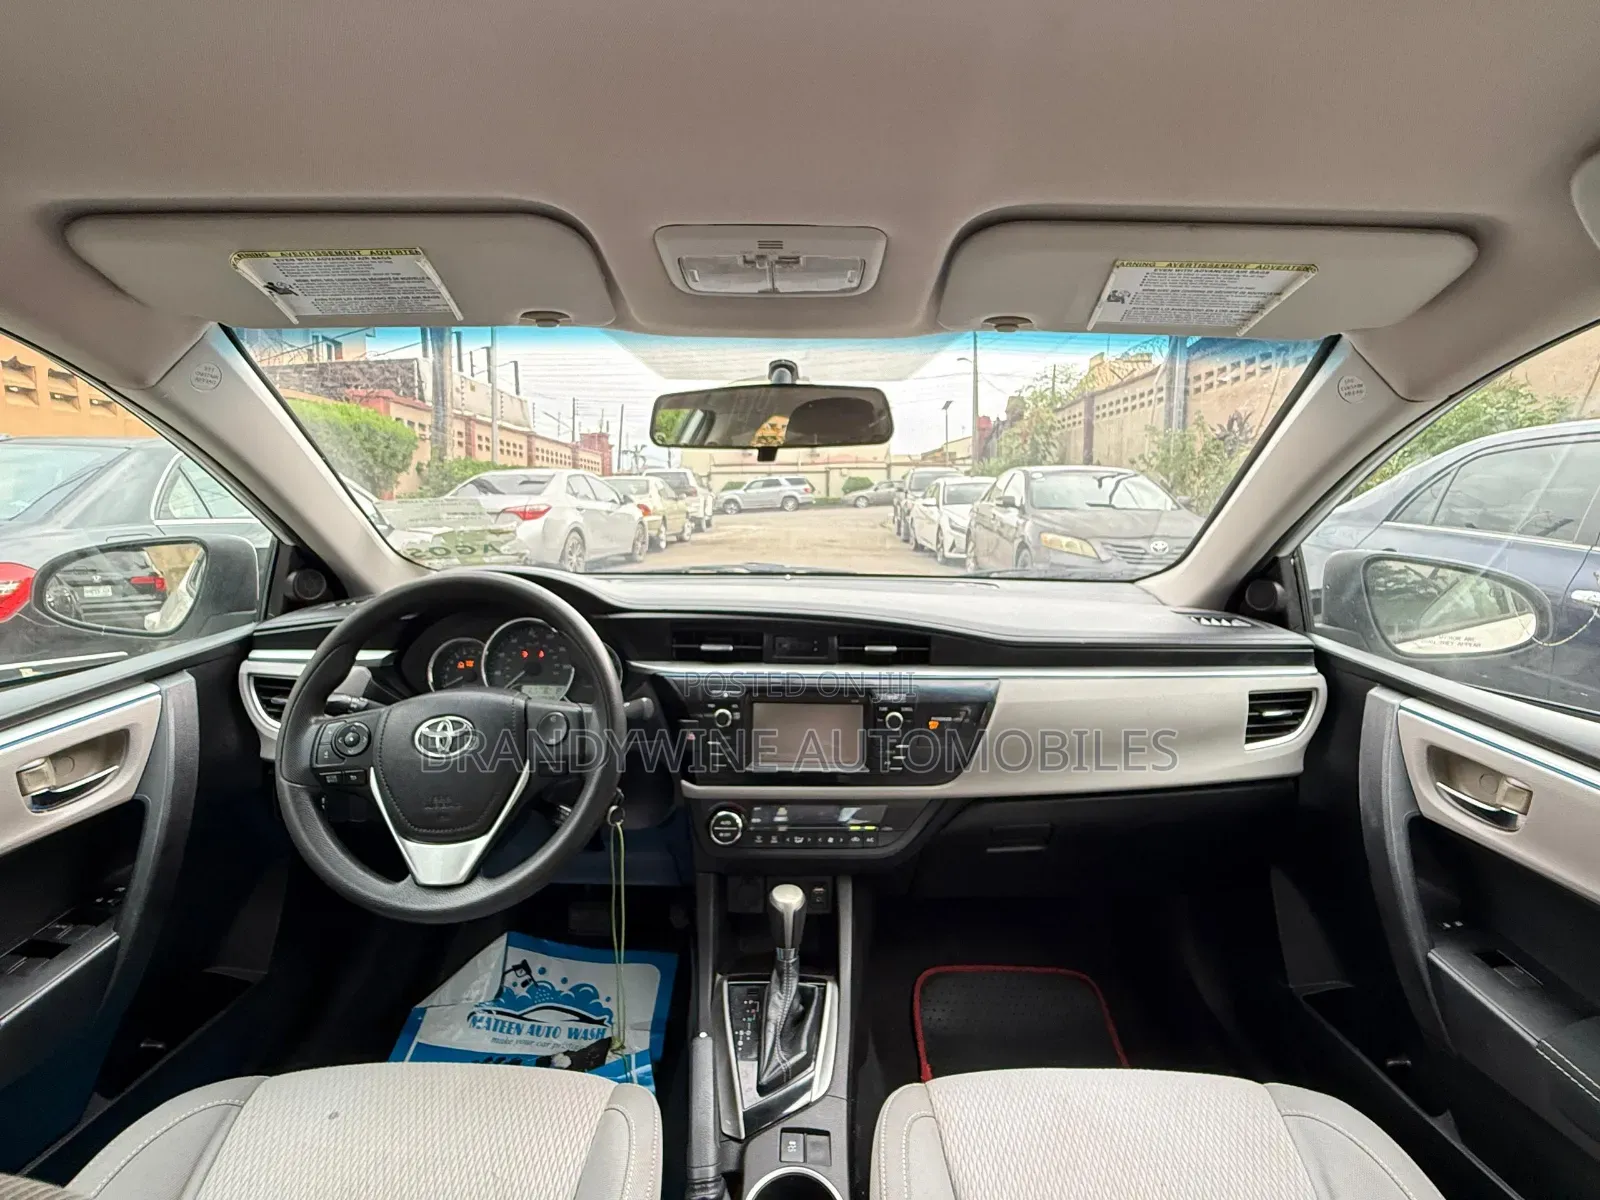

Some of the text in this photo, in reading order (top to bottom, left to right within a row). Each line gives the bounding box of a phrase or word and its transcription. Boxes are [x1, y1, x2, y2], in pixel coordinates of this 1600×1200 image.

[526, 1024, 561, 1039] AUTO
[567, 1026, 607, 1041] WASH
[491, 1036, 514, 1045] make
[515, 1039, 534, 1048] your
[536, 1040, 550, 1048] car
